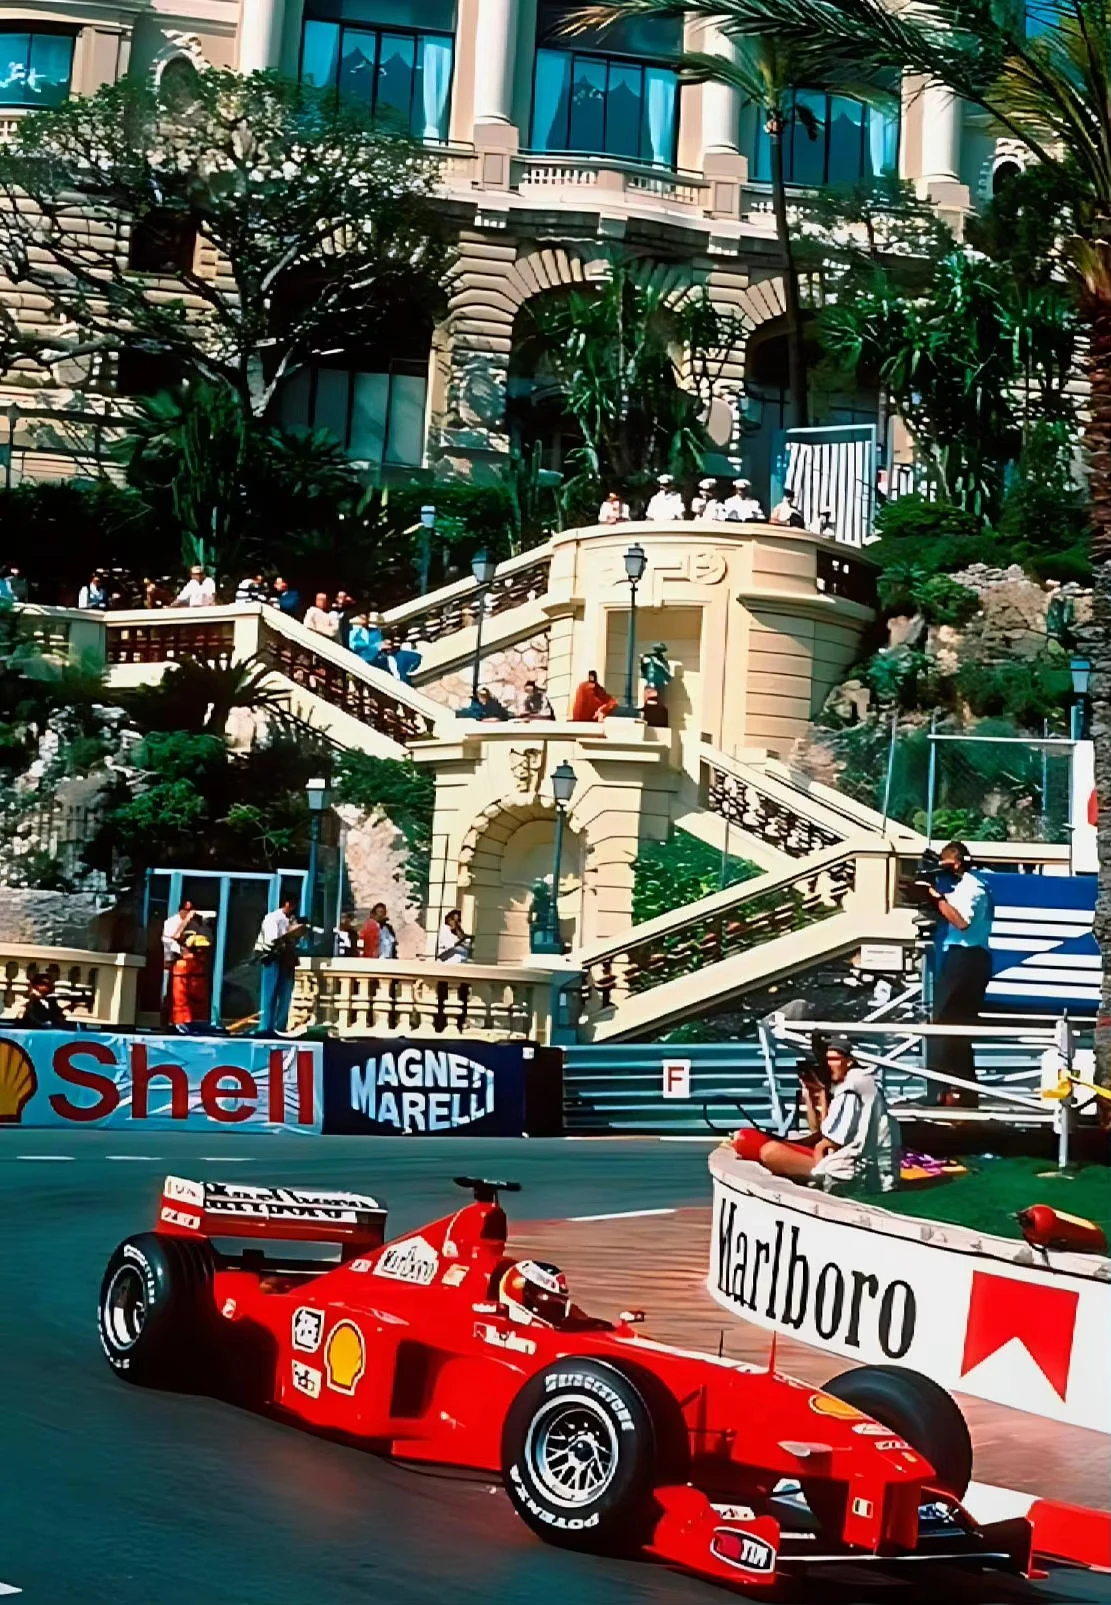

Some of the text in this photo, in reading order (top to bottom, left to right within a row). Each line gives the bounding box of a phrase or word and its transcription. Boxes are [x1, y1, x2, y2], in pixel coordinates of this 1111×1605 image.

[49, 1041, 314, 1125] Shell
[667, 1066, 685, 1092] F
[717, 1198, 917, 1359] Marlboro
